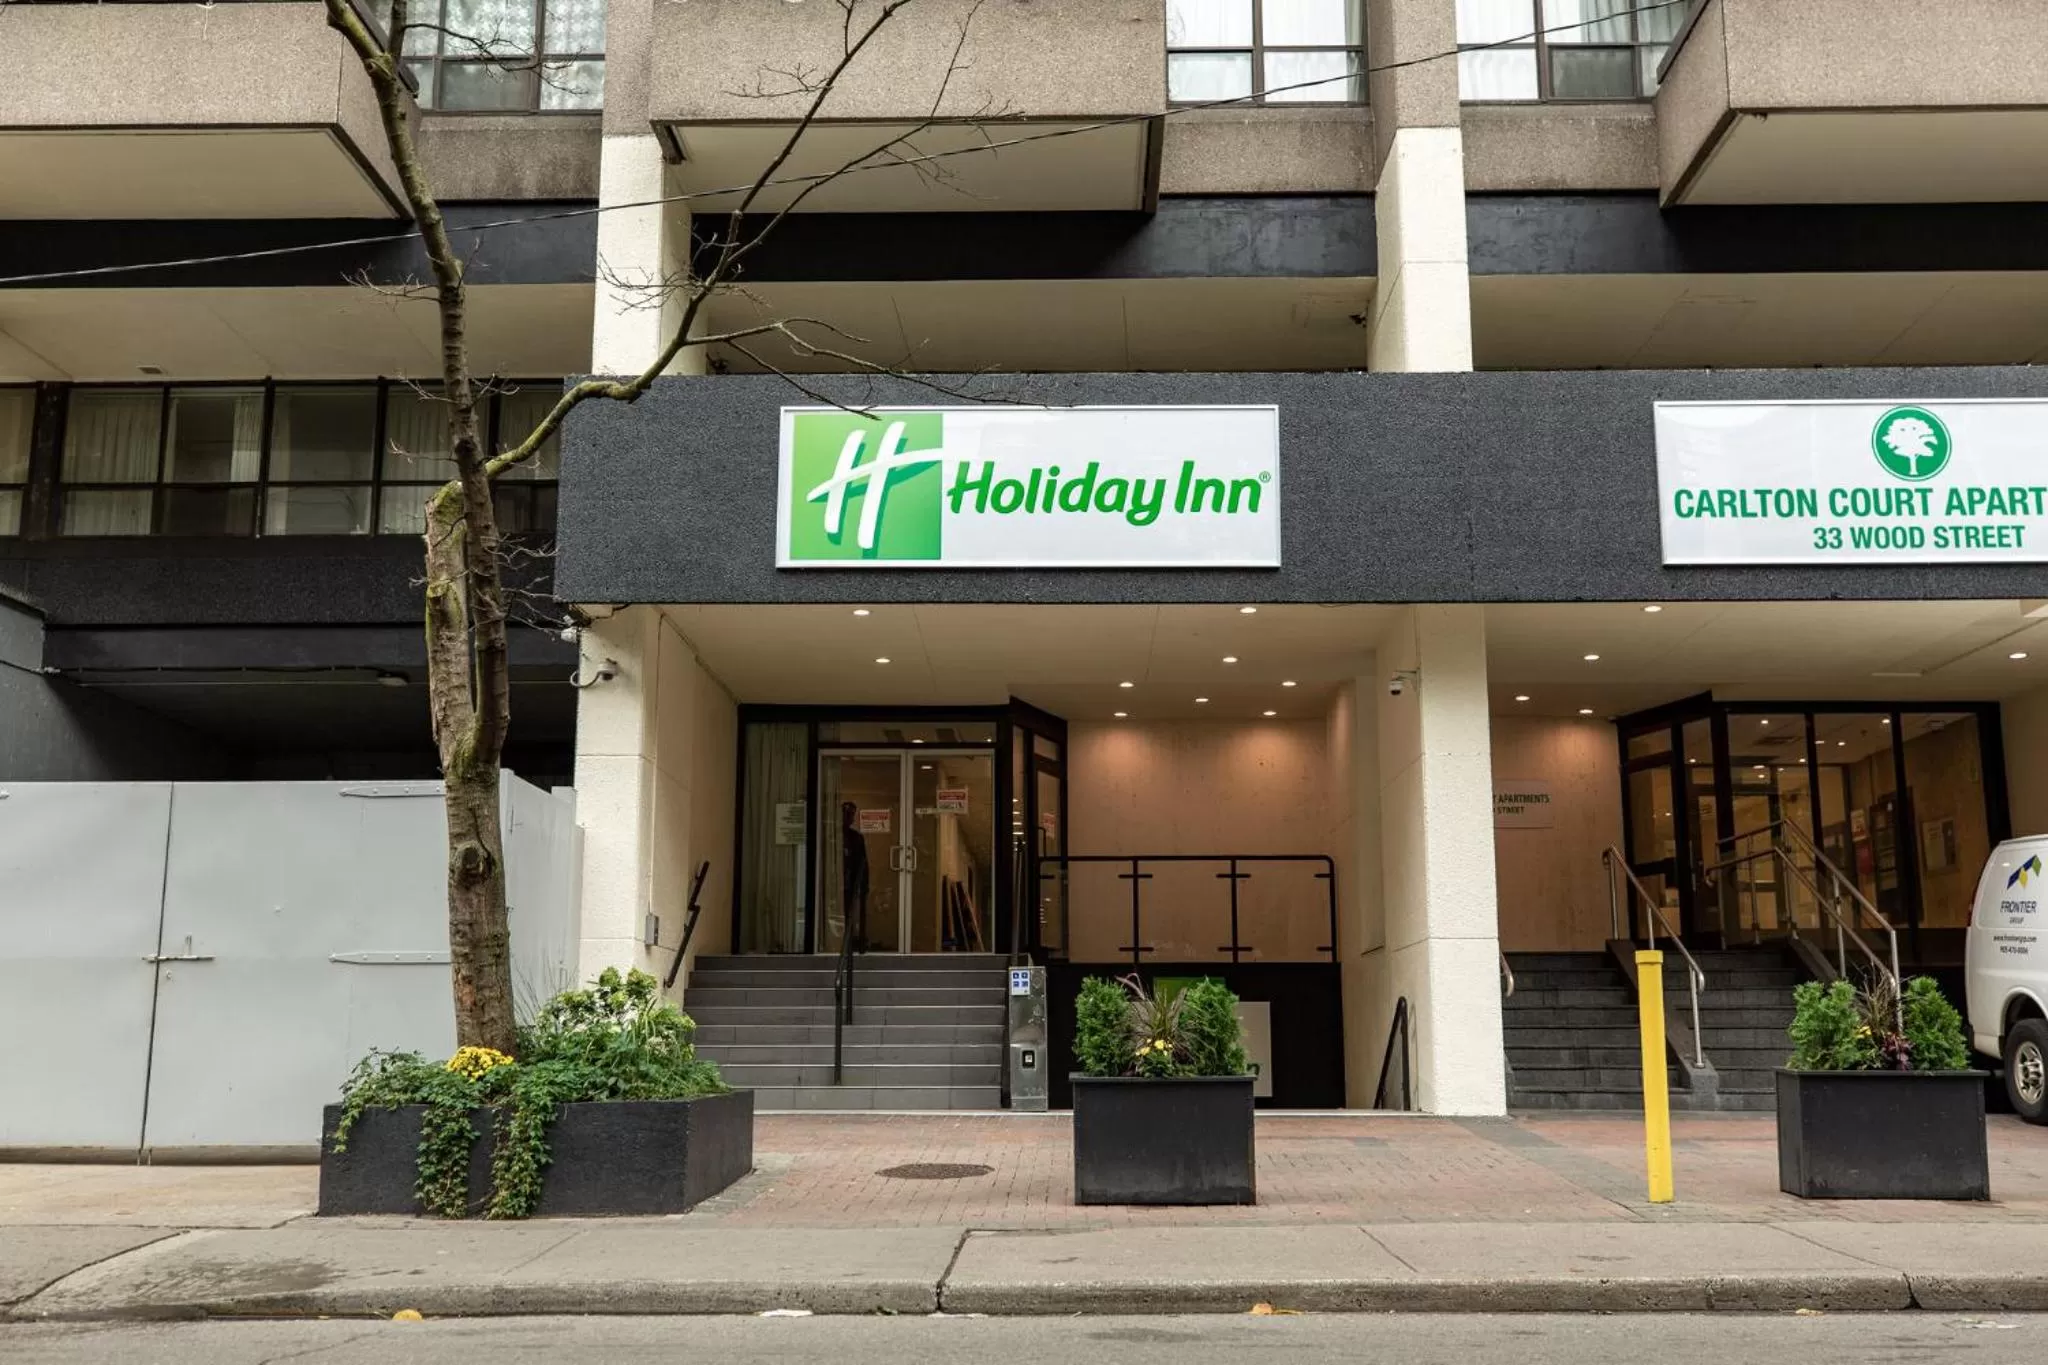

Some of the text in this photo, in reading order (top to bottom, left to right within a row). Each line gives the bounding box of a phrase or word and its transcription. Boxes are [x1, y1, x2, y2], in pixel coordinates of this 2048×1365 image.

[946, 460, 1166, 527] Holiday
[1674, 488, 1819, 519] CARLTON
[1828, 487, 1934, 517] COURT
[1813, 524, 2025, 550] 33 WOOD STREET
[1498, 794, 1550, 804] APARTMENTS
[2000, 901, 2037, 913] FRONTIER
